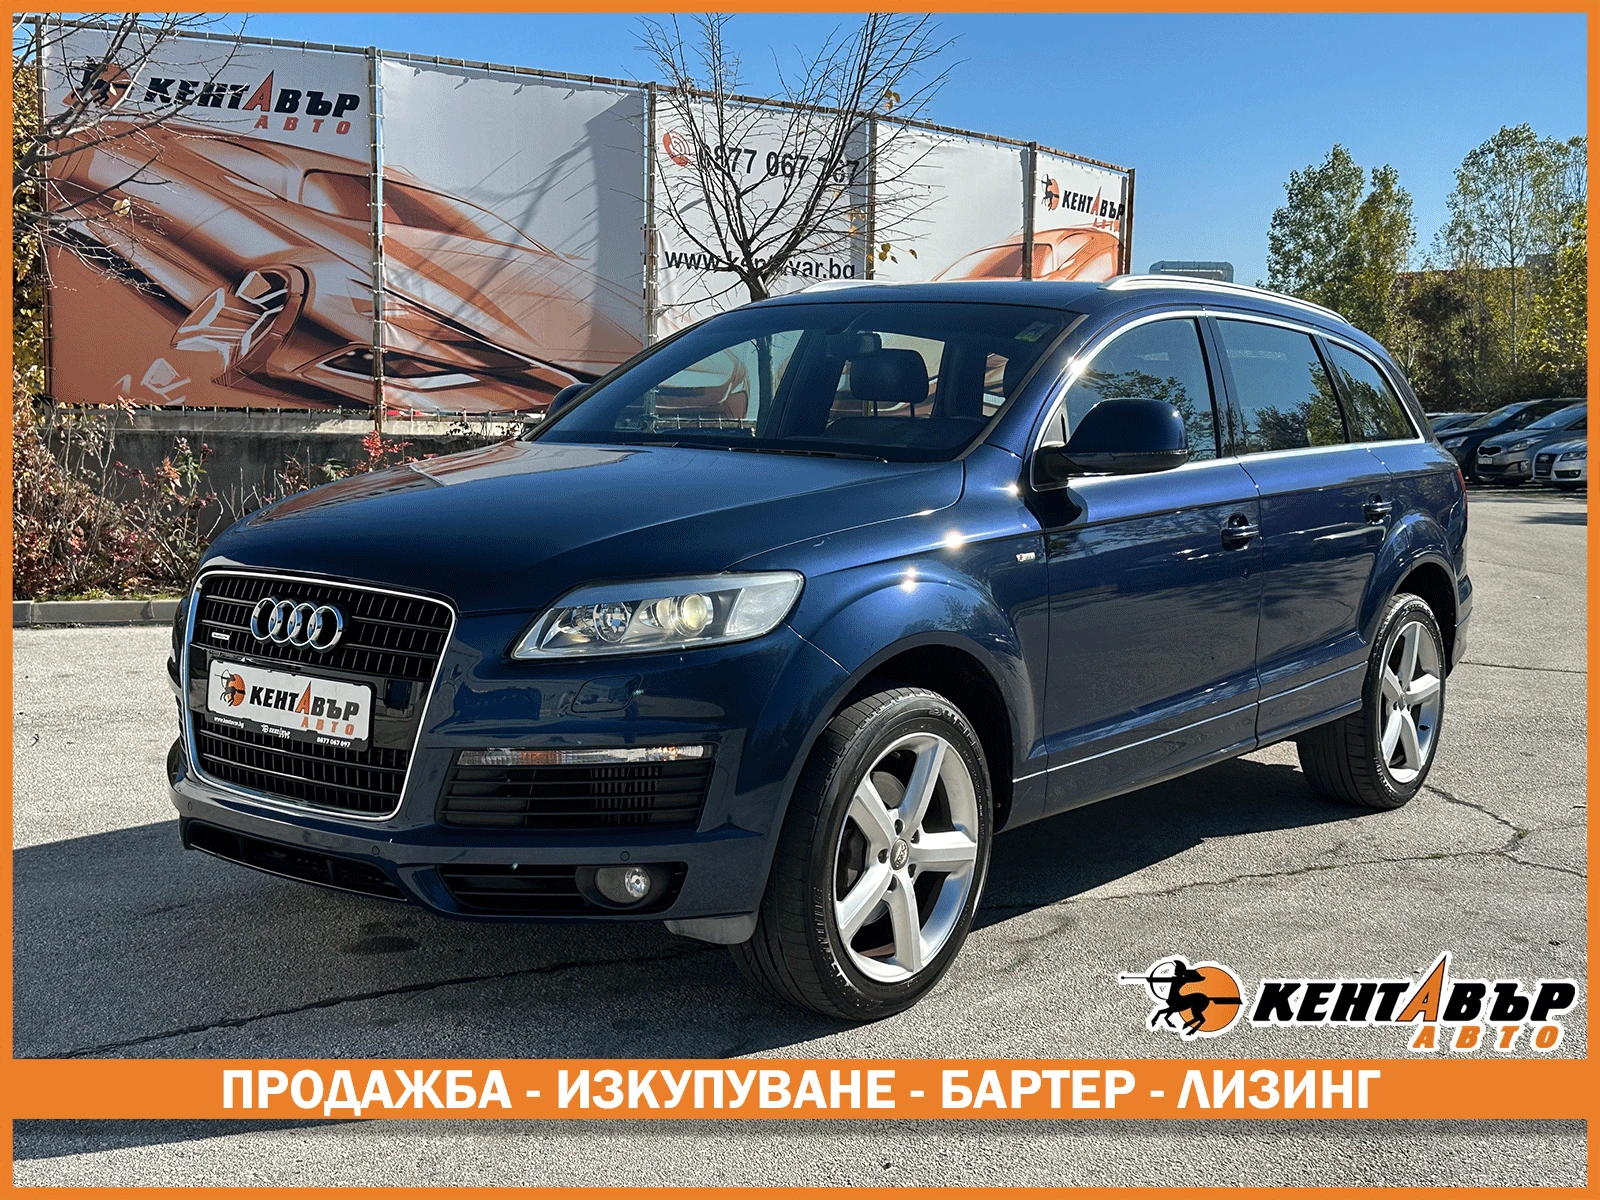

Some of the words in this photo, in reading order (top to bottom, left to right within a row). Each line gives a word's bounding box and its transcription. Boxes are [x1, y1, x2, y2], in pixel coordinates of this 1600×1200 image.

[143, 70, 360, 118] КЕНТАВЪР
[254, 114, 351, 135] АВТО
[766, 151, 809, 178] 067
[817, 156, 859, 186] 67
[1062, 186, 1126, 219] КЕНТАВЪР
[249, 681, 360, 721] КЕНТАВЪР
[301, 716, 356, 736] АВТО
